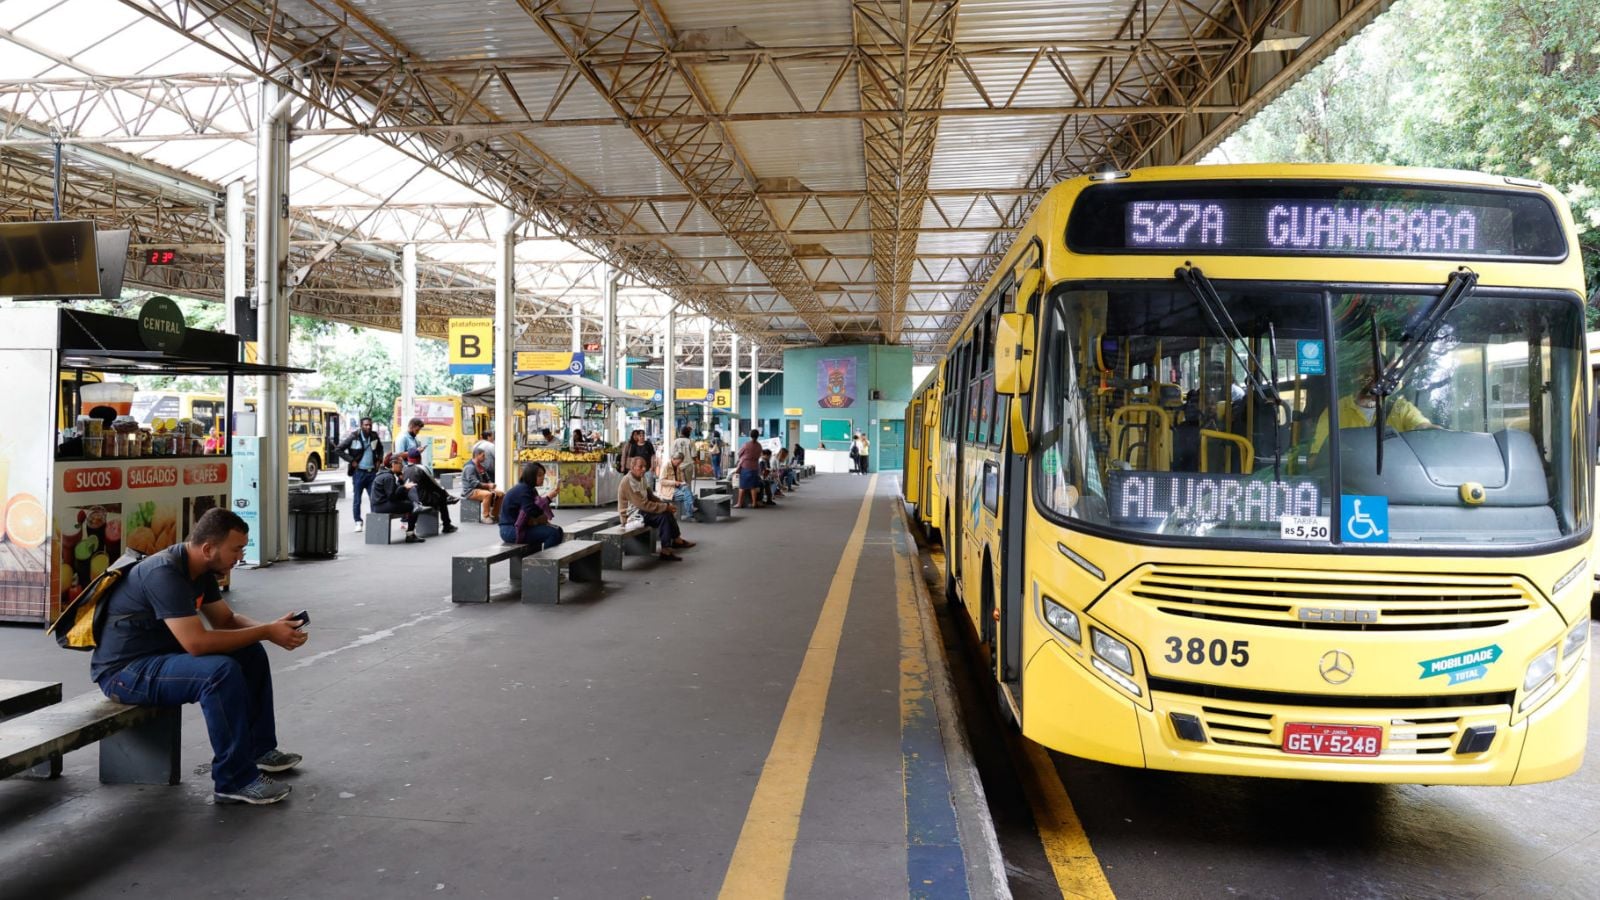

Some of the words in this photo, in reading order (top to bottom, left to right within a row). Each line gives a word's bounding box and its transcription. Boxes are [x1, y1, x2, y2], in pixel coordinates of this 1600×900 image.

[1131, 202, 1224, 244] 527A
[1267, 206, 1476, 250] GUANABARA
[143, 317, 180, 334] CENTRAL
[451, 320, 490, 328] plataforma
[460, 334, 481, 359] B
[716, 395, 726, 406] B
[76, 471, 112, 488] SUCOS
[130, 468, 176, 485] SALGADOS
[193, 466, 218, 482] CAFÉS
[1122, 476, 1317, 521] ALVORADA
[1293, 517, 1318, 525] TARIFA
[1296, 525, 1328, 539] 5,50
[1164, 635, 1250, 668] 3805
[1431, 648, 1494, 673] MOBILIDADE
[1455, 669, 1479, 681] TOTAL
